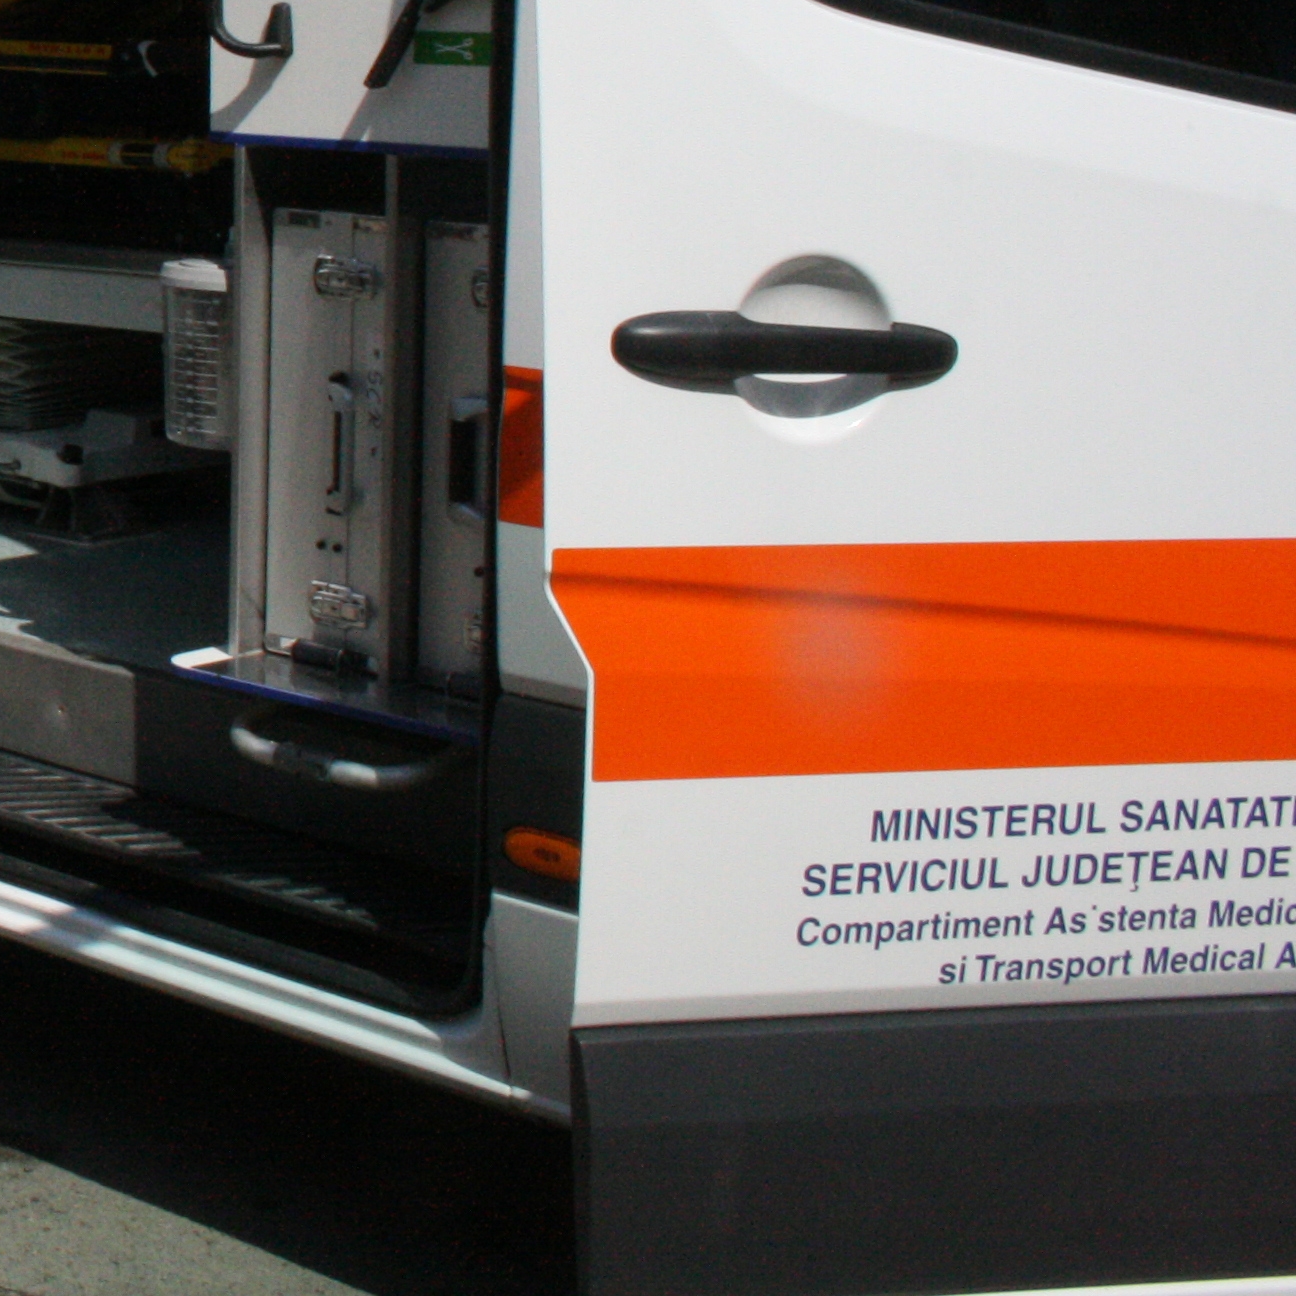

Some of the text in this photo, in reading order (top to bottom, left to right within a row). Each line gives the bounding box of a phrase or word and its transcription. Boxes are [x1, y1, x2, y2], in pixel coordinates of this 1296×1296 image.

[870, 802, 1106, 843] MINISTERUL
[802, 857, 1008, 897] SERVICIUL
[1241, 846, 1292, 879] DE
[796, 910, 1034, 950] Compartiment
[938, 955, 967, 984] si
[975, 950, 1132, 985] Transport
[1143, 942, 1266, 975] Medical
